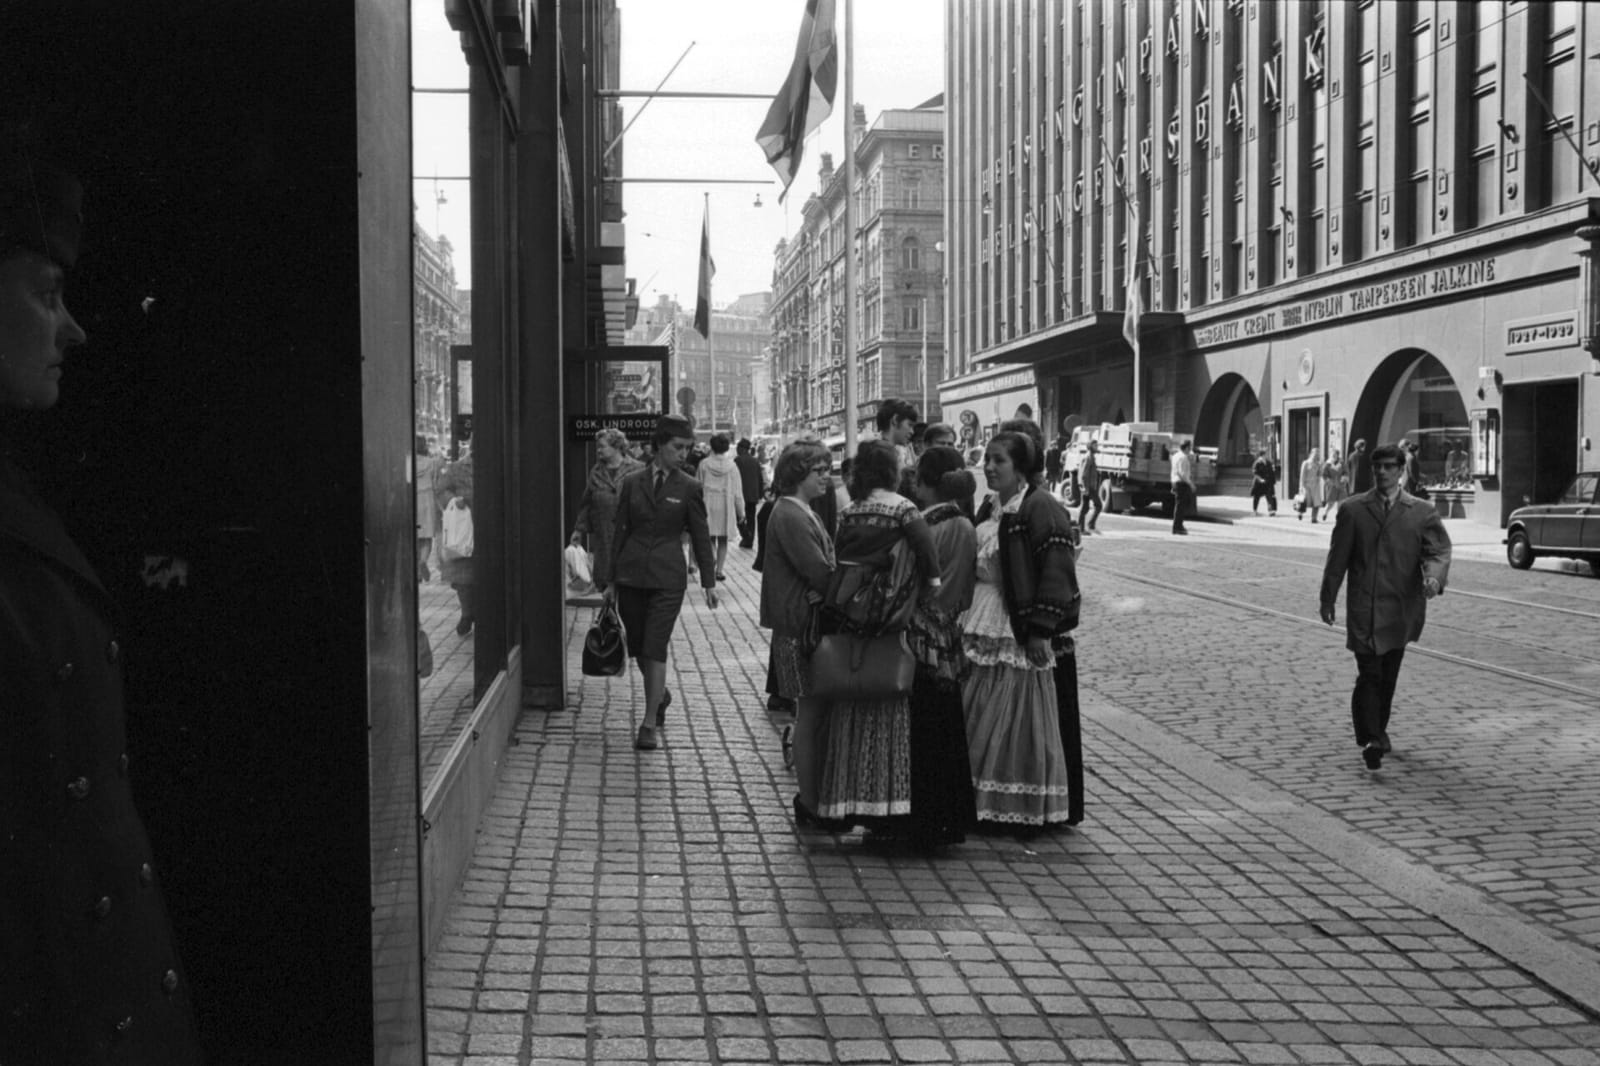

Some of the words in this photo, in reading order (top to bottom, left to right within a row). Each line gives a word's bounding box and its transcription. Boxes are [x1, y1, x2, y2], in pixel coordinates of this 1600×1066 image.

[1349, 273, 1427, 311] TAMPEREEN
[1431, 258, 1496, 294] JALKINE
[1304, 295, 1343, 322] NYBLIN
[1207, 321, 1239, 343] BEAUTY
[1244, 312, 1276, 336] CREDIT
[575, 419, 600, 429] OSK.
[602, 419, 657, 429] LINDROOS
